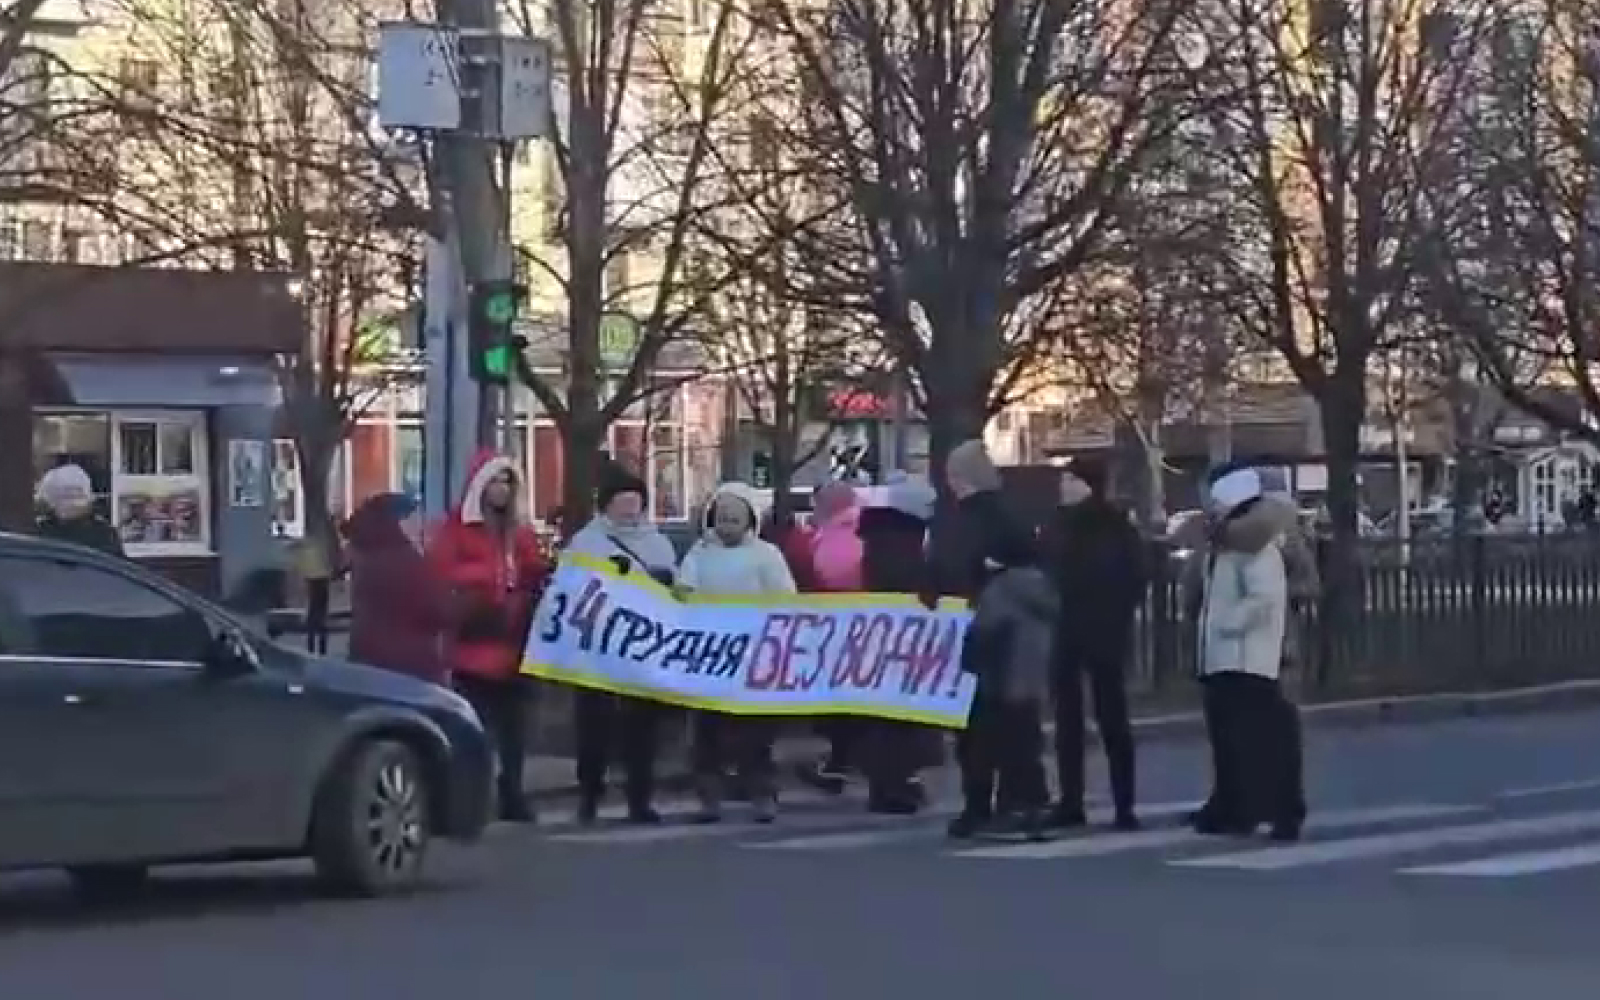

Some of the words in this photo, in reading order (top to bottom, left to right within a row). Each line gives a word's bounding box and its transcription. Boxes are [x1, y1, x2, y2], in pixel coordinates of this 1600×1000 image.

[541, 592, 568, 643] З
[567, 576, 608, 652] 4
[600, 606, 750, 678] ГРУДНЯ
[745, 612, 836, 691] БЕЗ
[829, 611, 959, 699] ВОДИ!
